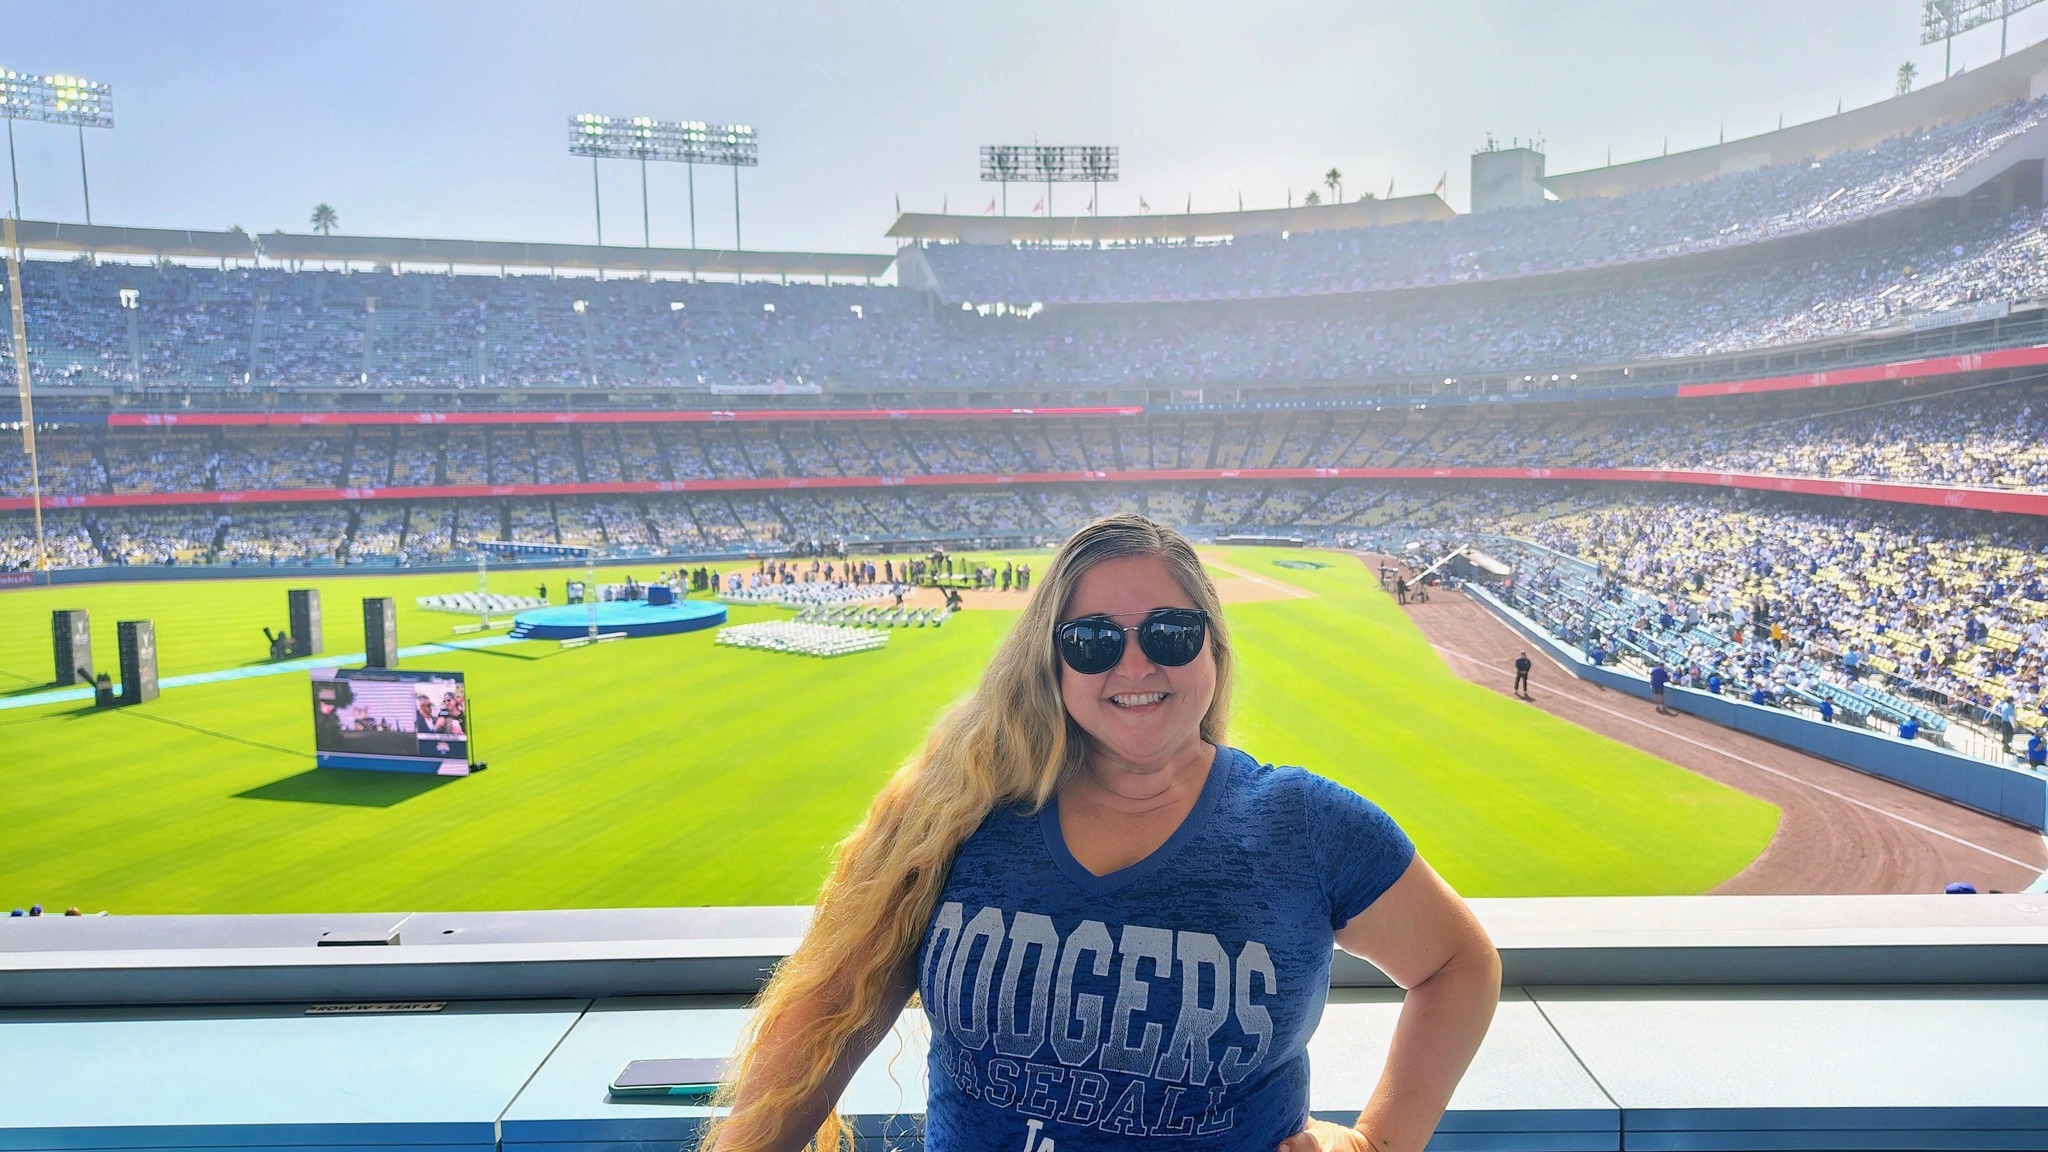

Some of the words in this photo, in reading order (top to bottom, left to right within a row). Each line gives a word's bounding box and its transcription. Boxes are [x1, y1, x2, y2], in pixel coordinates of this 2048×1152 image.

[0, 575, 33, 585] akult
[920, 901, 1278, 1086] DODGERS
[938, 1037, 1234, 1137] BASEBALL
